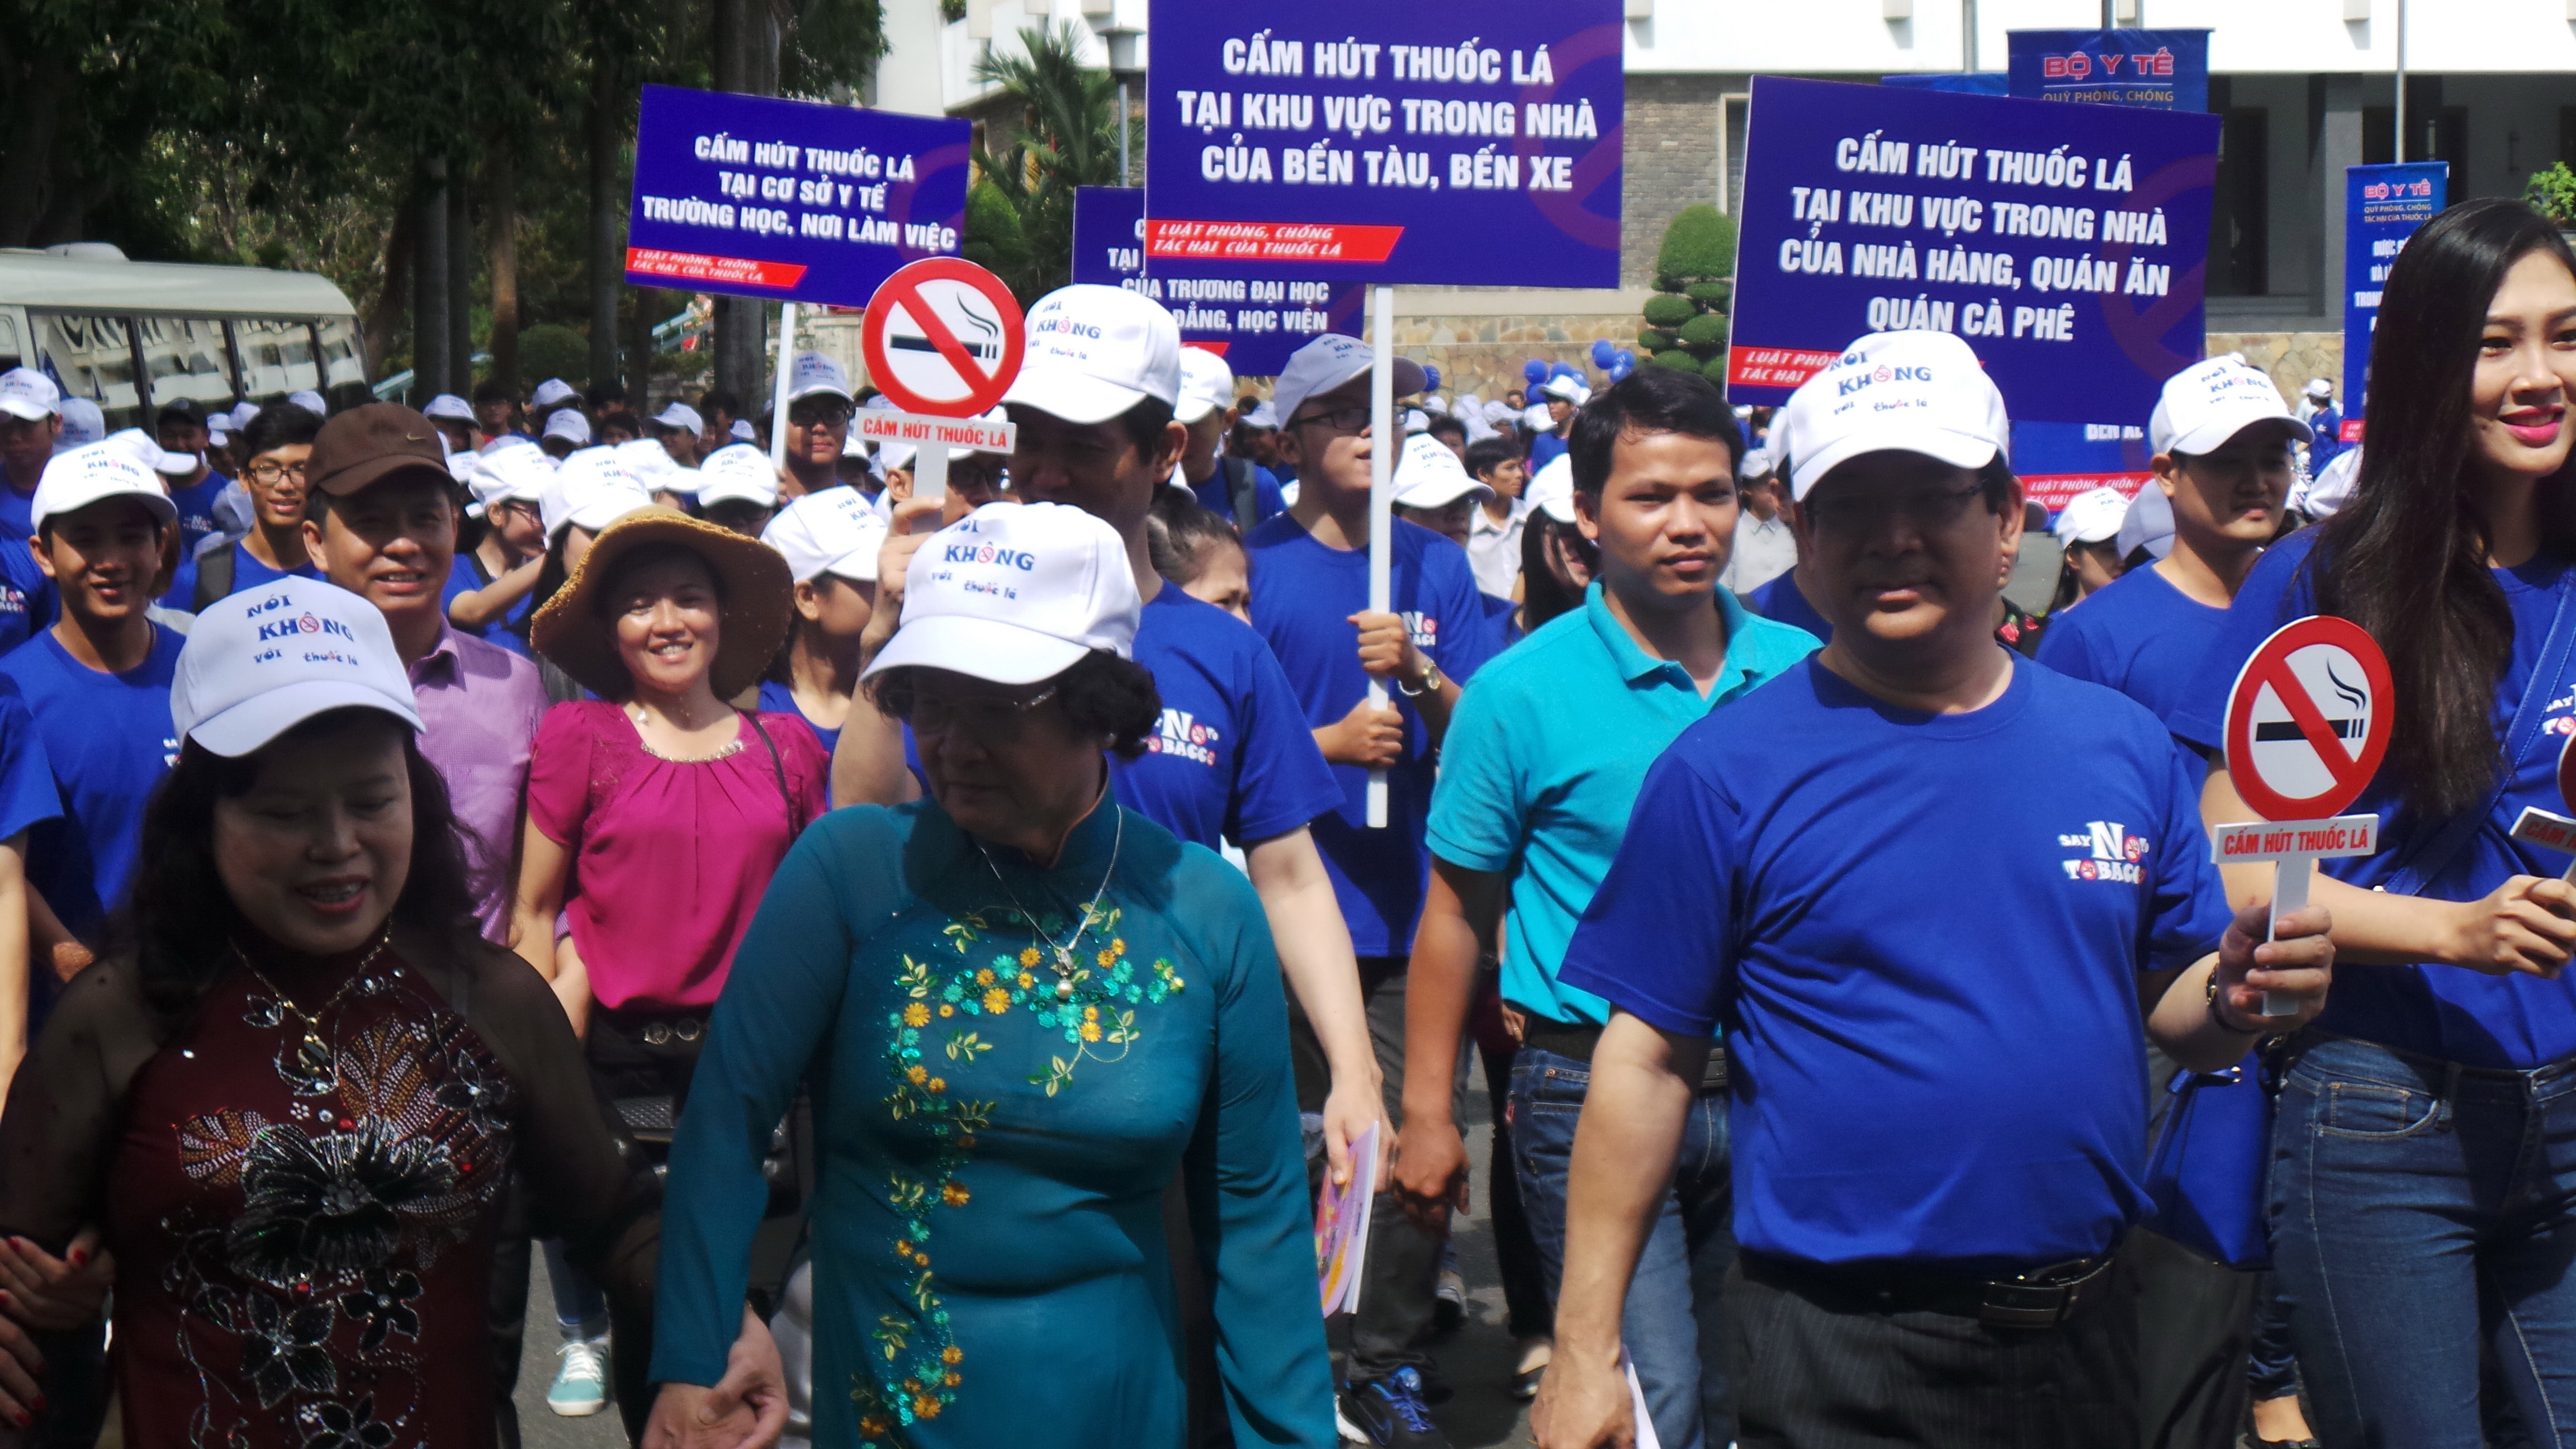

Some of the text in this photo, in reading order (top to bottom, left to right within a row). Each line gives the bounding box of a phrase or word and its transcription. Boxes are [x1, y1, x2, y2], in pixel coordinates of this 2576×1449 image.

[1223, 28, 1554, 84] CẤM HÚT THUỐC LÁ
[2044, 46, 2174, 80] BỘ Y TẾ
[2127, 88, 2174, 102] CHỐNG
[1177, 91, 1598, 139] TẠI KHU VỰC TRONG NHÀ
[695, 131, 914, 181] CẤM HÚT THUỐC LÁ
[1201, 134, 1572, 190] CỦA BẾN TÀU, BẾN XE
[1836, 130, 2133, 192] CẤM HÚT THUỐC LÁ
[719, 171, 888, 210] TẠI CƠ SỞ Y TẾ
[2365, 182, 2389, 200] BỘ
[2392, 183, 2406, 196] Y
[642, 196, 956, 253] TRƯỜNG HỌC, NƠI LÀM VIỆC
[1158, 222, 1204, 237] LUẬT
[1206, 224, 1270, 239] PHÒNG,
[1275, 224, 1334, 239] CHỐNG
[1793, 187, 2167, 246] TẠI KHU VỰC TRONG NHÀ
[1108, 248, 1138, 271] TẠI
[1153, 239, 1342, 254] TÁC HẠI CỦA THUỐC LÁ
[1779, 227, 2170, 296] CỦA NHÀ HÀNG, QUÁN ĂN
[1251, 281, 1284, 304] ĐẠI
[1290, 282, 1329, 304] HỌC
[1238, 311, 1277, 334] HỌC
[1283, 309, 1328, 334] VIỆN
[1868, 296, 2075, 342] QUÁN CÀ PHÊ
[1740, 367, 1806, 383] TÁC HẠI
[863, 415, 1007, 447] CẤM HÚT THUỐC LÁ
[2058, 834, 2091, 847] SAY
[2224, 825, 2368, 856] CẤM HÚT THUỐC LÁ
